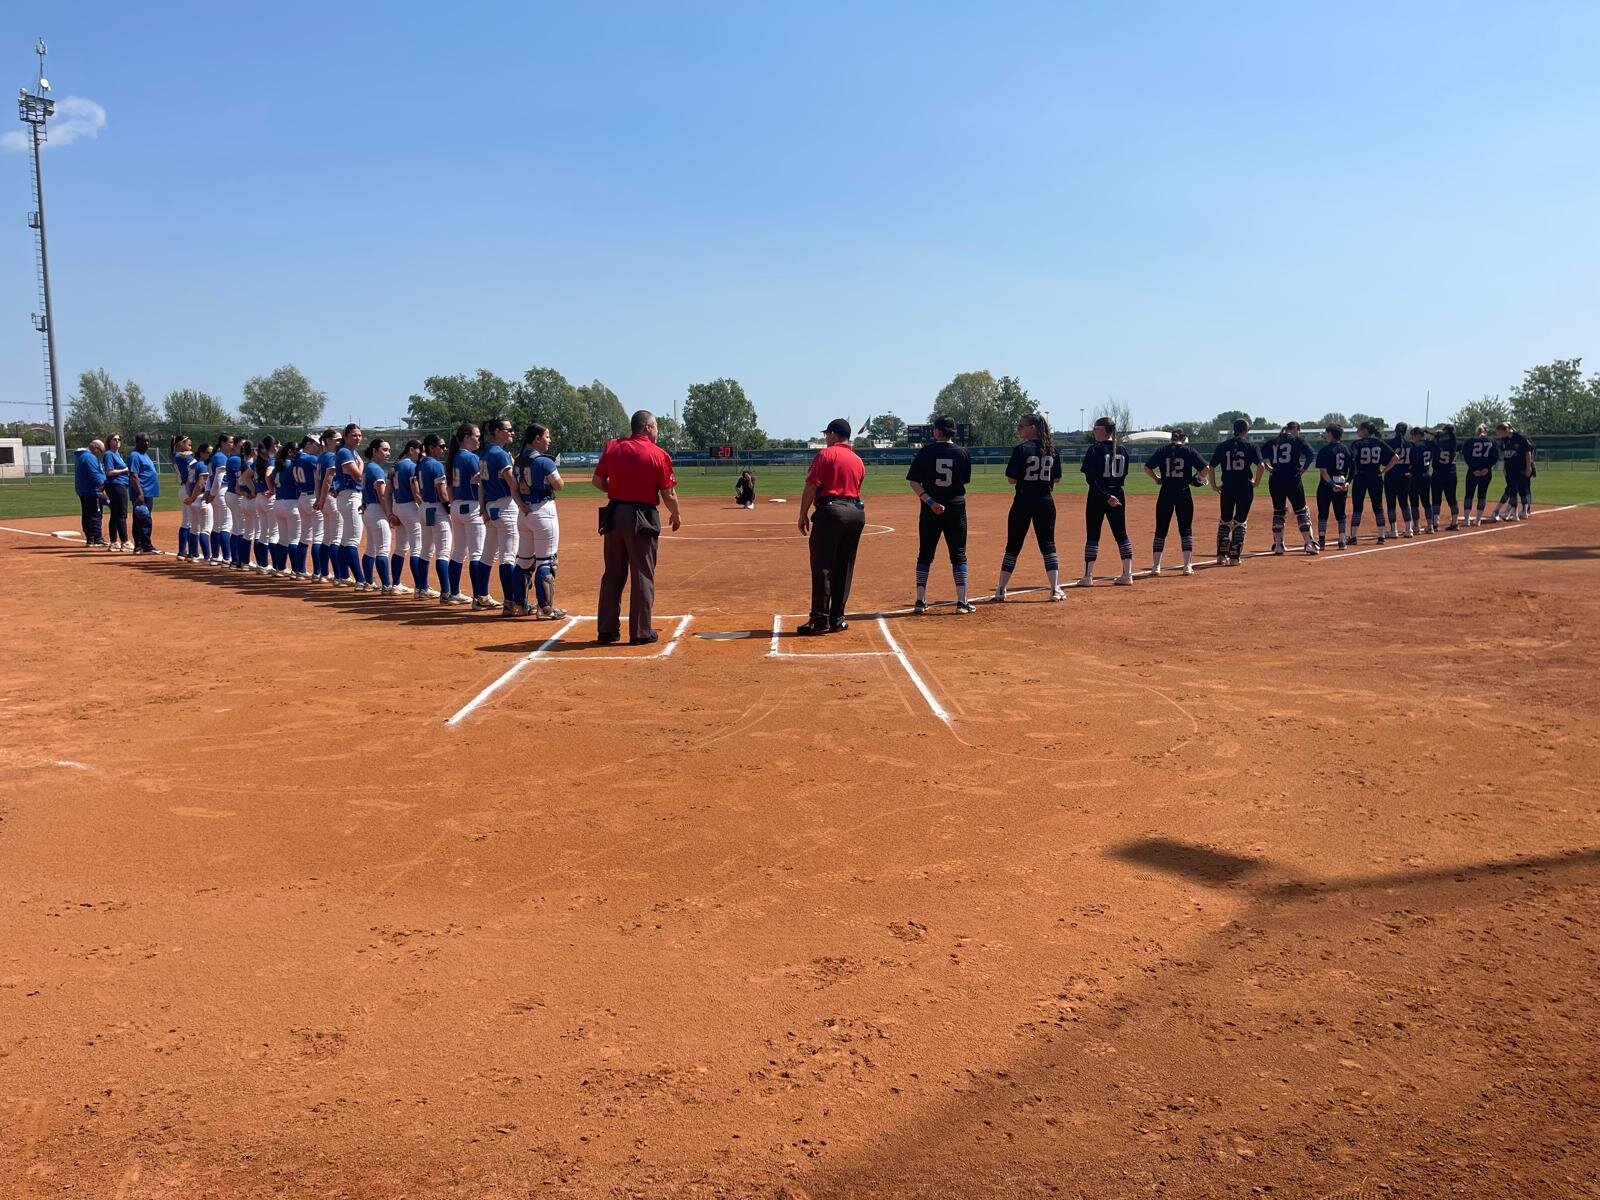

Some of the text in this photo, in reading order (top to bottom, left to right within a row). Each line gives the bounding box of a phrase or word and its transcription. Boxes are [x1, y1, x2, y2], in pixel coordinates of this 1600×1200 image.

[718, 446, 731, 457] 20
[1272, 443, 1292, 463] 13
[1360, 446, 1380, 464] 99
[1471, 442, 1492, 457] 27
[1024, 455, 1053, 481] 28
[1102, 453, 1124, 478] 10
[1165, 457, 1184, 478] 12
[1335, 453, 1344, 470] 6
[935, 458, 953, 487] 5
